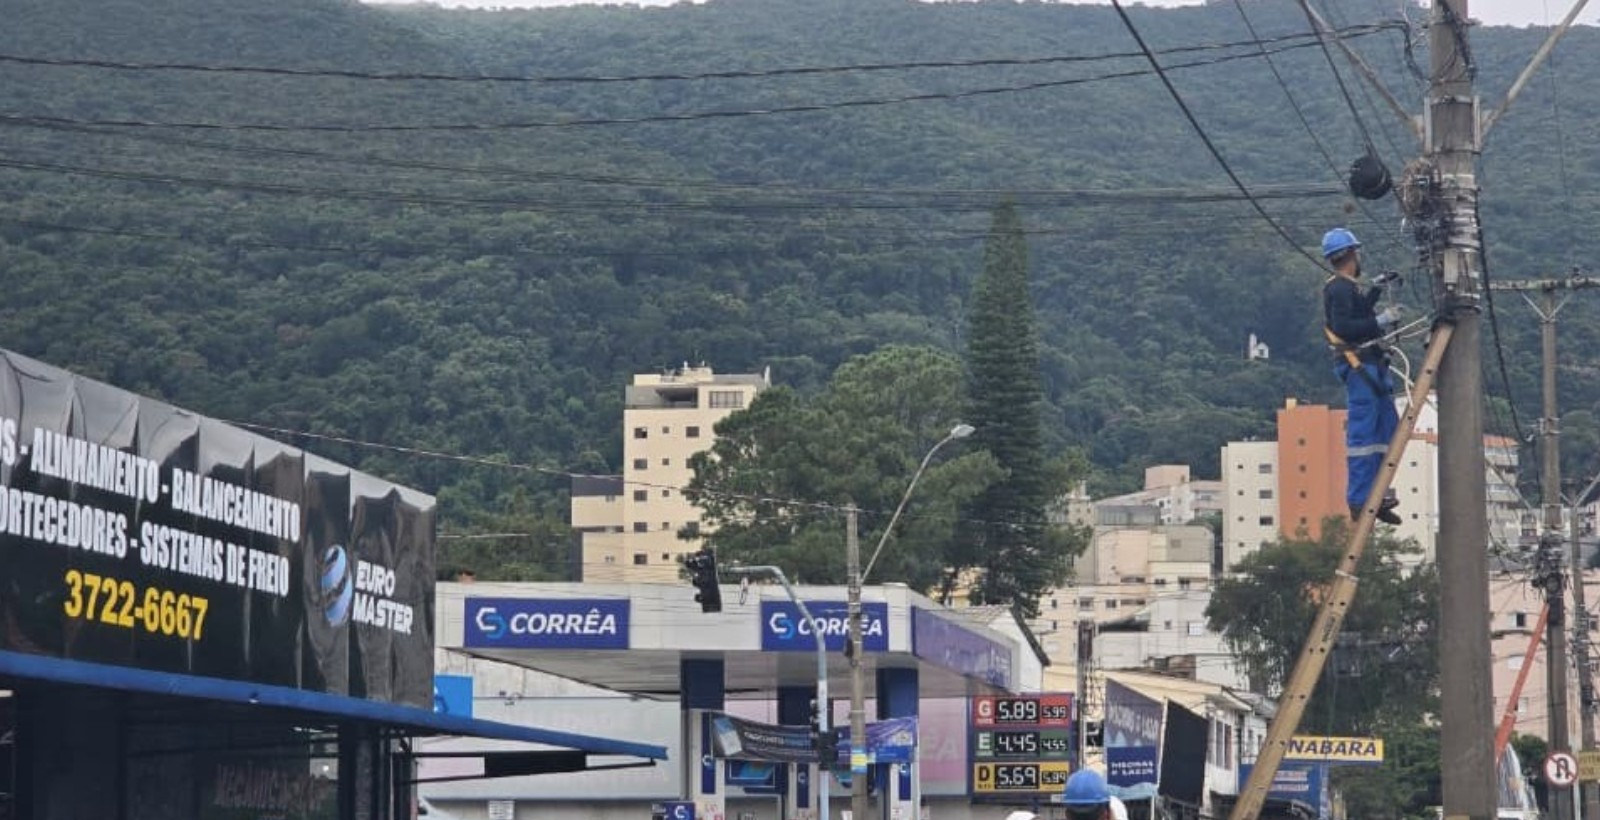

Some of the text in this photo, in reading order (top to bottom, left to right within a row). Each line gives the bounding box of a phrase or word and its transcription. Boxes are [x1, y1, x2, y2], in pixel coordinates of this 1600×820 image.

[0, 417, 16, 466] S
[31, 427, 159, 503] ALINHAMENTO
[171, 468, 300, 542] BALANCEAMENTO
[0, 485, 127, 559] ORTECEDORES
[141, 521, 224, 582] SISTEMAS
[227, 545, 246, 585] DE
[248, 552, 290, 598] FREIO
[356, 560, 395, 597] EURO
[64, 570, 208, 640] 3722-6667
[352, 592, 413, 635] MASTER
[510, 607, 616, 636] CORRÊA
[978, 699, 992, 717] G
[998, 701, 1037, 720] 5.89
[978, 733, 991, 750] E
[998, 734, 1037, 752] 4.45
[979, 766, 991, 782] D
[998, 766, 1037, 785] 5.69
